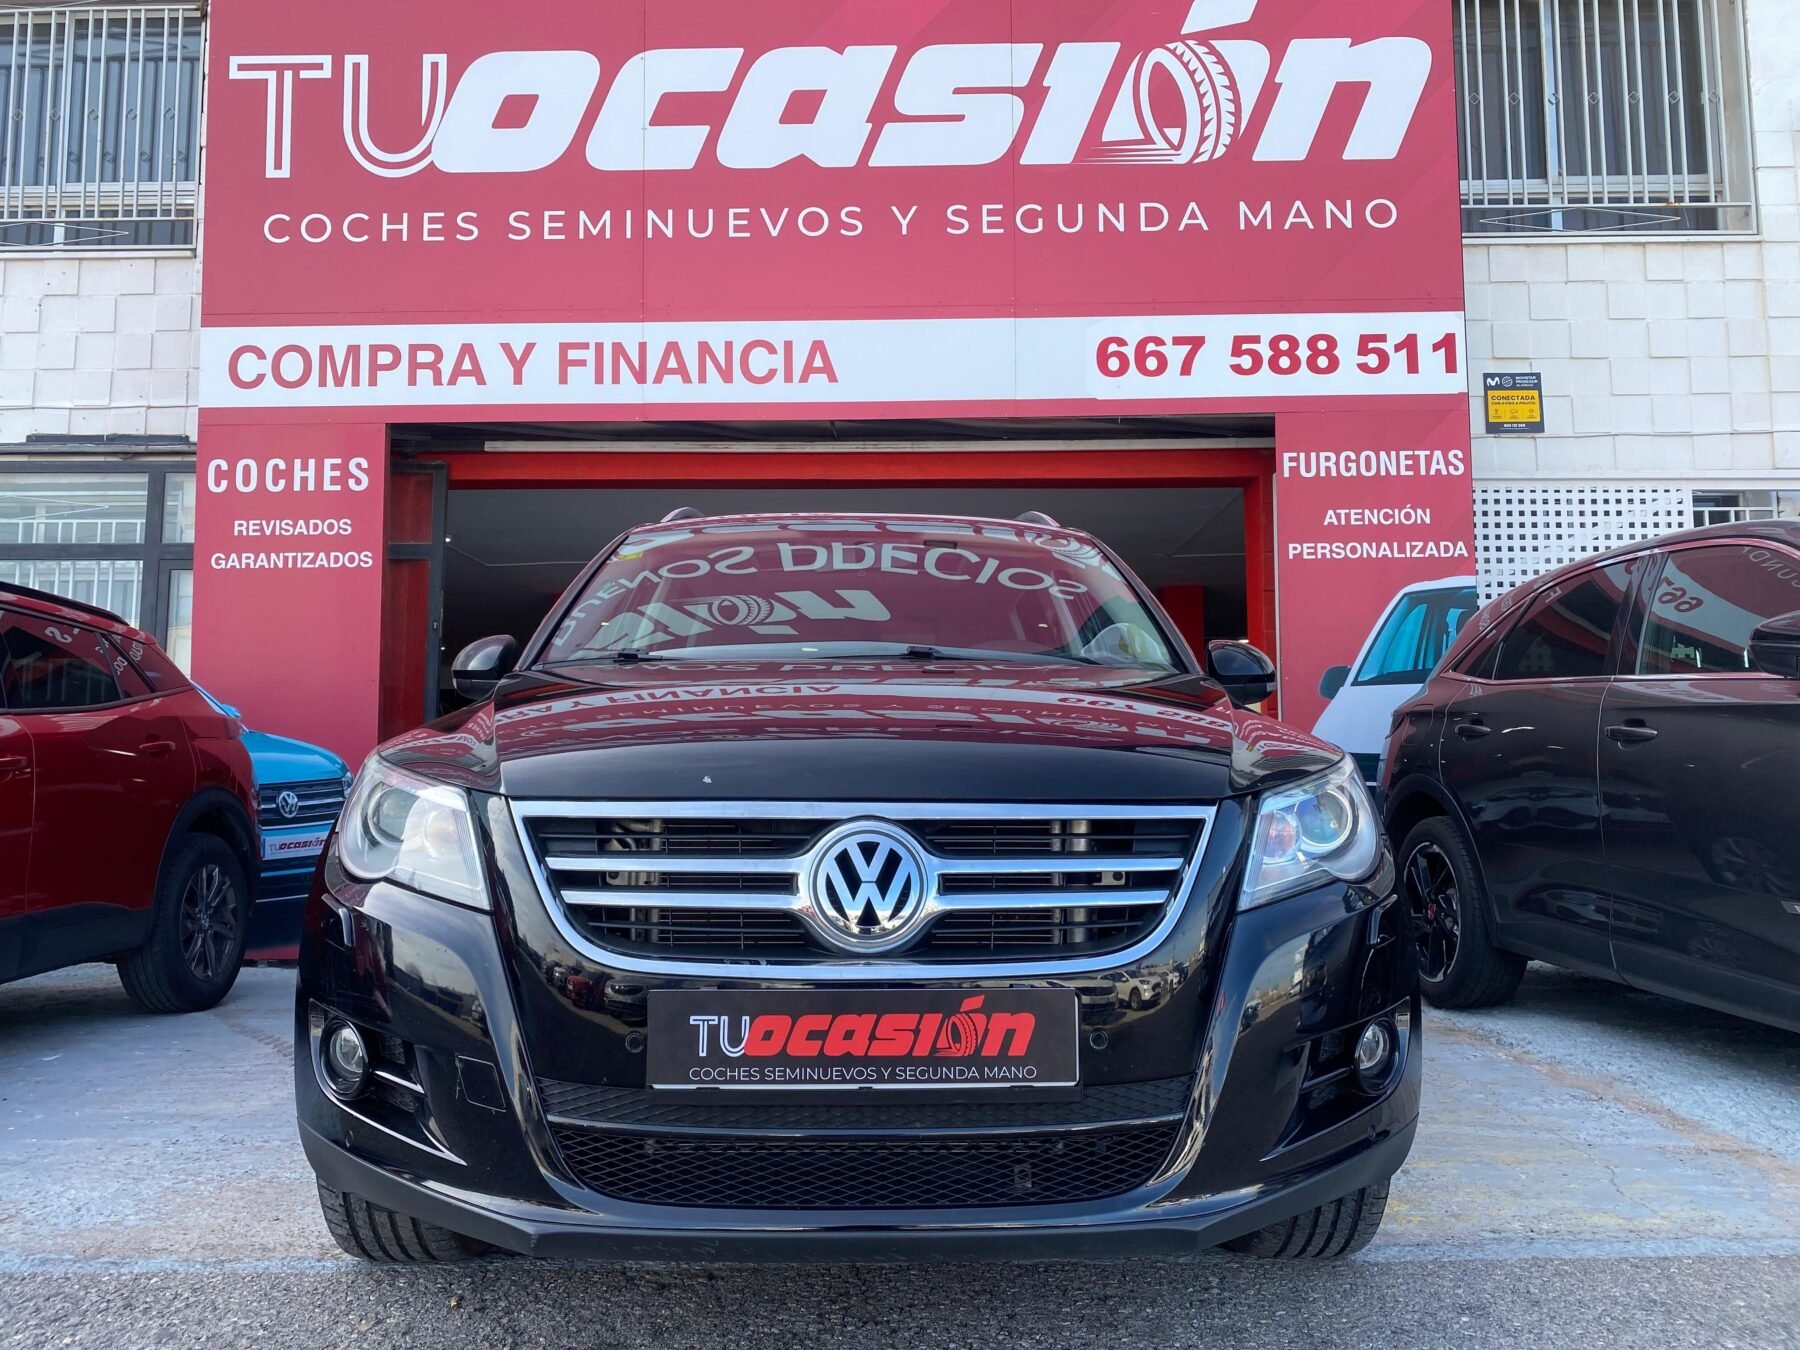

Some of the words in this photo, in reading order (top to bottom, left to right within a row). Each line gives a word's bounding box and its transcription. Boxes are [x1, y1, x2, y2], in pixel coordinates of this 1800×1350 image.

[263, 211, 479, 244] COCHES
[508, 206, 863, 241] SEMINUEVOS
[890, 205, 918, 235] Y
[946, 202, 1209, 235] SEGUNDA
[1239, 198, 1398, 230] MANO
[228, 342, 487, 390] COMPRA
[499, 342, 537, 386] Y
[558, 339, 839, 385] FINANCIA
[1095, 335, 1206, 378] 667
[1229, 333, 1340, 376] 588
[1356, 332, 1458, 375] 511
[207, 457, 369, 493] COCHES
[1283, 449, 1465, 478] FURGONETAS
[233, 518, 352, 536] REVISADOS
[1323, 503, 1431, 526] ATENCIÓN
[210, 551, 373, 570] GARANTIZADOS
[1288, 541, 1469, 560] PERSONALIZADA
[689, 1067, 760, 1081] COCHES
[764, 1066, 877, 1081] SEMINUEVOS
[880, 1066, 892, 1080] Y
[895, 1066, 980, 1080] SEGUNDA
[984, 1065, 1037, 1080] MANO
